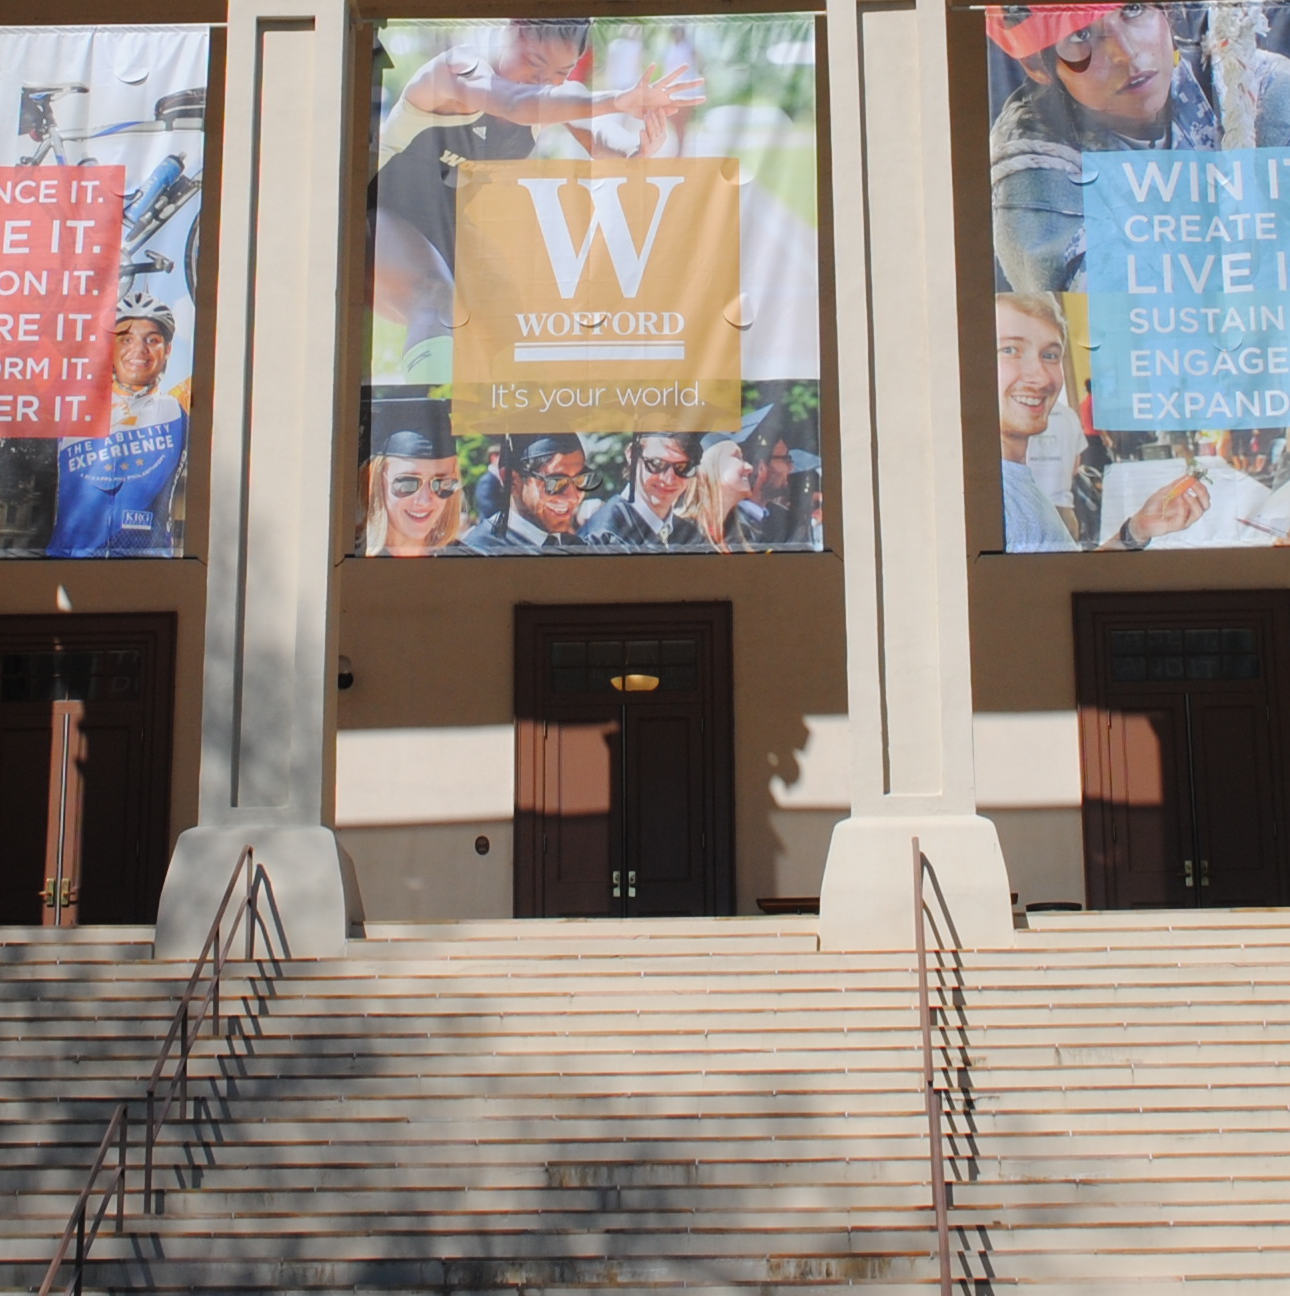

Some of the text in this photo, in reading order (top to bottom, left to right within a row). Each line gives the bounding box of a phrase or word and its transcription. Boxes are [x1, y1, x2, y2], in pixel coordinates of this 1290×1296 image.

[71, 181, 103, 203] IT.
[1122, 160, 1244, 202] WIN
[51, 220, 100, 254] IT.
[518, 176, 684, 299] W
[1124, 213, 1277, 242] CREATE
[63, 271, 98, 295] IT.
[1128, 252, 1255, 294] LIVE
[57, 314, 96, 341] IT.
[516, 312, 684, 336] WOFFORD
[1130, 305, 1285, 333] SUSTAIN
[62, 358, 92, 380] IT.
[1131, 348, 1290, 376] ENGAGE
[55, 396, 90, 421] IT.
[492, 381, 705, 412] It's your world.
[1132, 390, 1290, 419] EXPAND
[67, 423, 171, 457] THE ABILITY
[68, 435, 174, 472] EXPERIENCE
